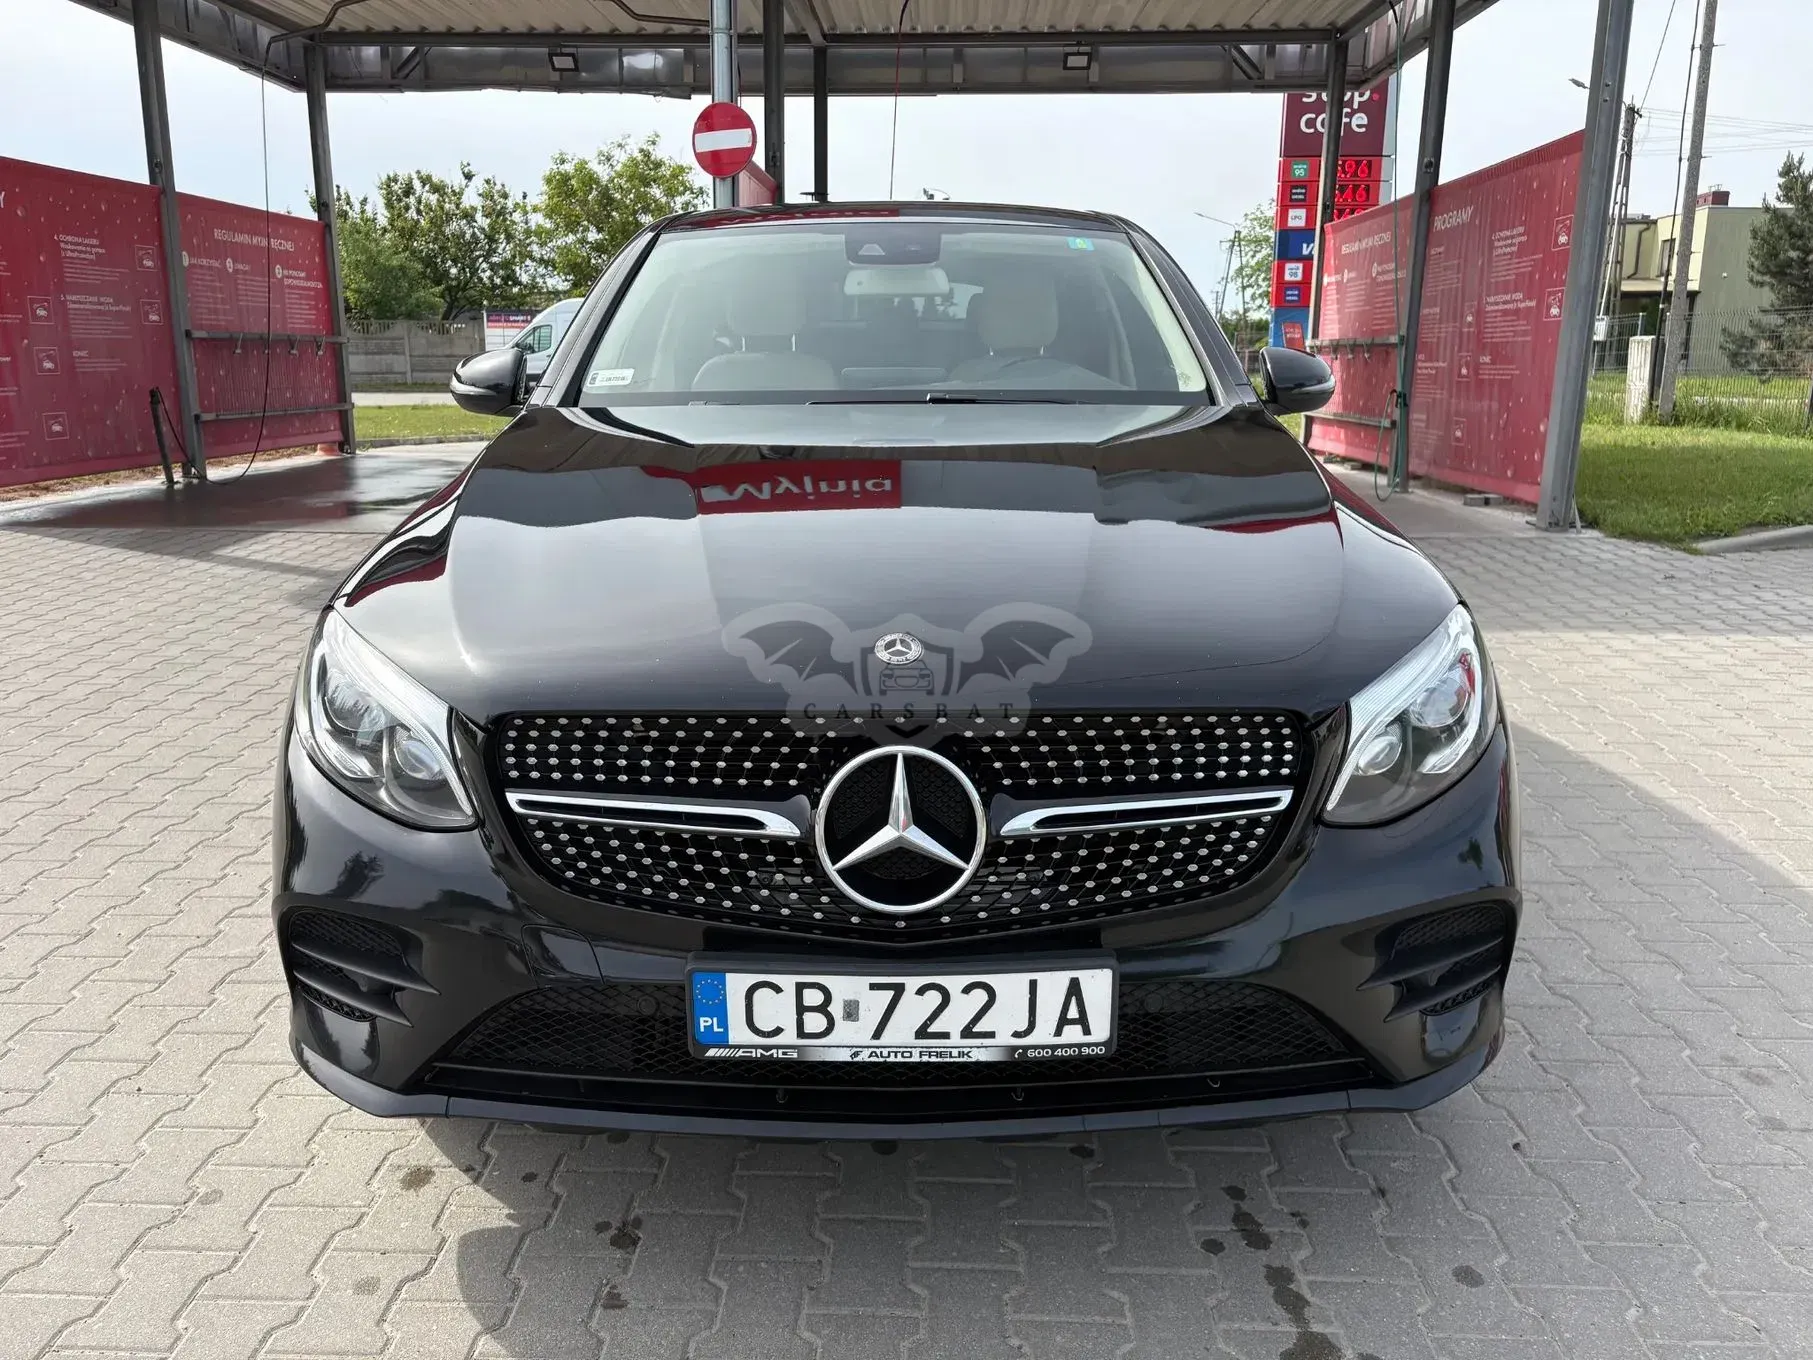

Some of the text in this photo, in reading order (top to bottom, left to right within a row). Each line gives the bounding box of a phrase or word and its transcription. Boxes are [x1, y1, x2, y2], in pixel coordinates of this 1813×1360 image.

[1433, 206, 1474, 232] PROGRAMY
[214, 229, 251, 245] REGULAMIN
[744, 977, 1092, 1040] CB 722JA
[699, 1017, 724, 1033] PL
[733, 1048, 798, 1058] AMG
[867, 1050, 913, 1059] AUTO
[918, 1050, 973, 1059] FRELIK
[1027, 1046, 1106, 1058] 600 400 900
